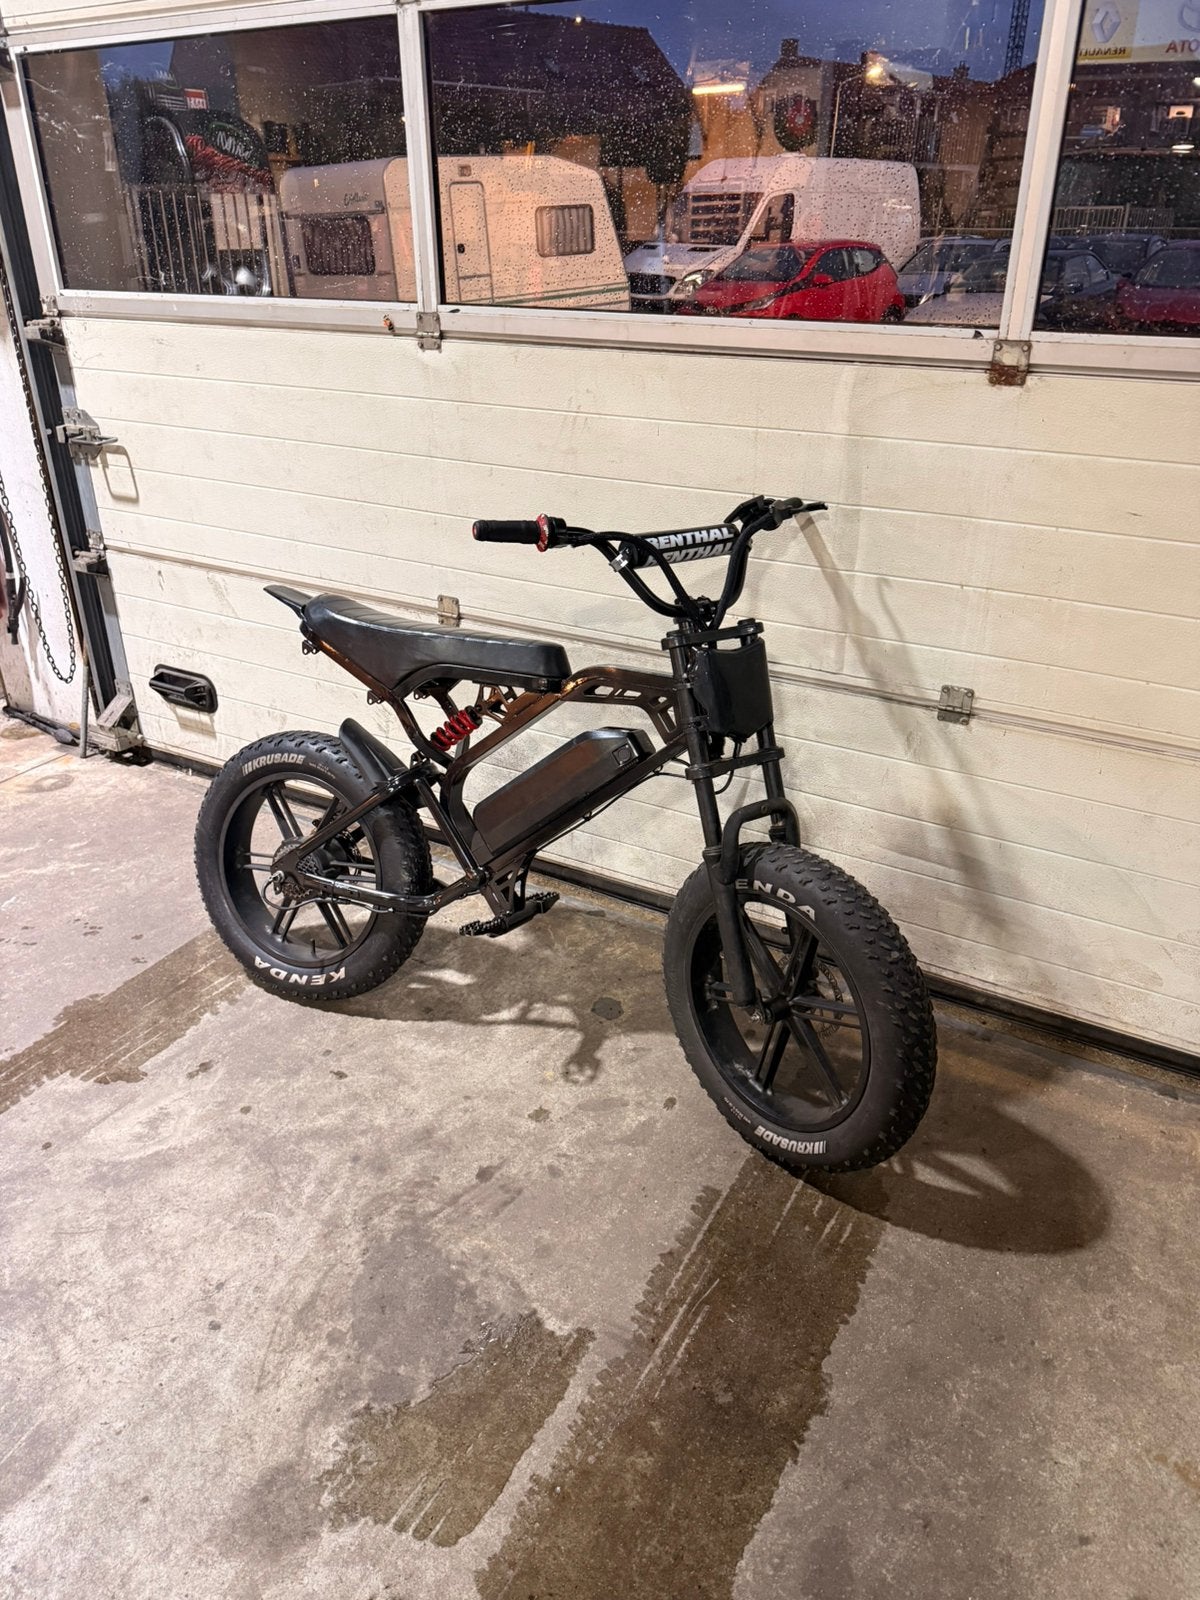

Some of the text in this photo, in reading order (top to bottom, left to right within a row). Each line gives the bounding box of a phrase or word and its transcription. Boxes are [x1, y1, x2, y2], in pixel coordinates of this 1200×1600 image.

[252, 752, 306, 771] KRUSADE
[735, 878, 816, 921] ENDA
[254, 955, 346, 986] KENDA
[754, 1125, 814, 1155] KRUSADE
